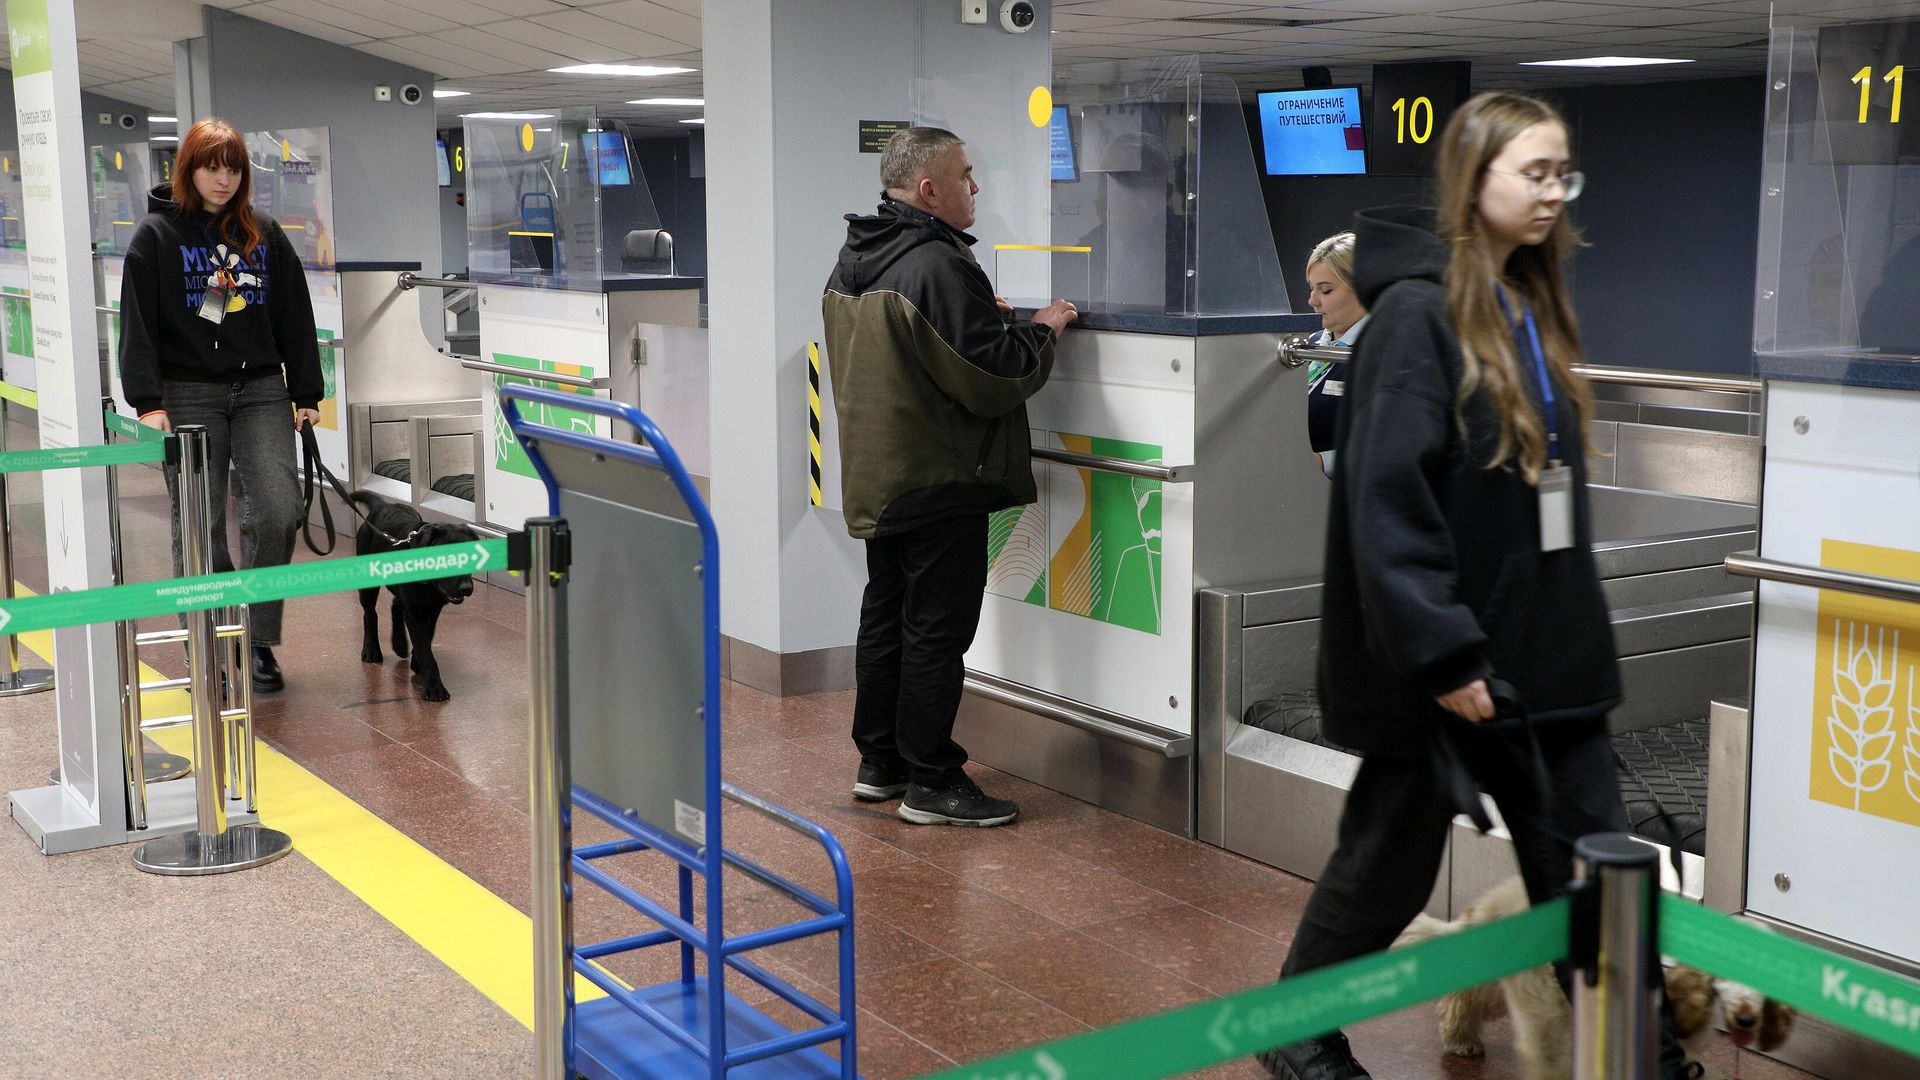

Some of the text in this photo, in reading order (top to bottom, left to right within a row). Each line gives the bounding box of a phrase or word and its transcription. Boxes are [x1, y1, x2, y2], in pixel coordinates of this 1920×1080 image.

[1277, 97, 1344, 111] ОГРАНИЧЕНИЕ
[1850, 64, 1904, 124] 11
[1279, 110, 1347, 126] ПУТЕШЕСТВИЙ
[1391, 96, 1434, 144] 10
[455, 146, 463, 172] 6
[560, 142, 569, 169] 7
[369, 551, 469, 578] Краснодар
[156, 577, 242, 597] международный
[176, 591, 225, 606] аэропорт
